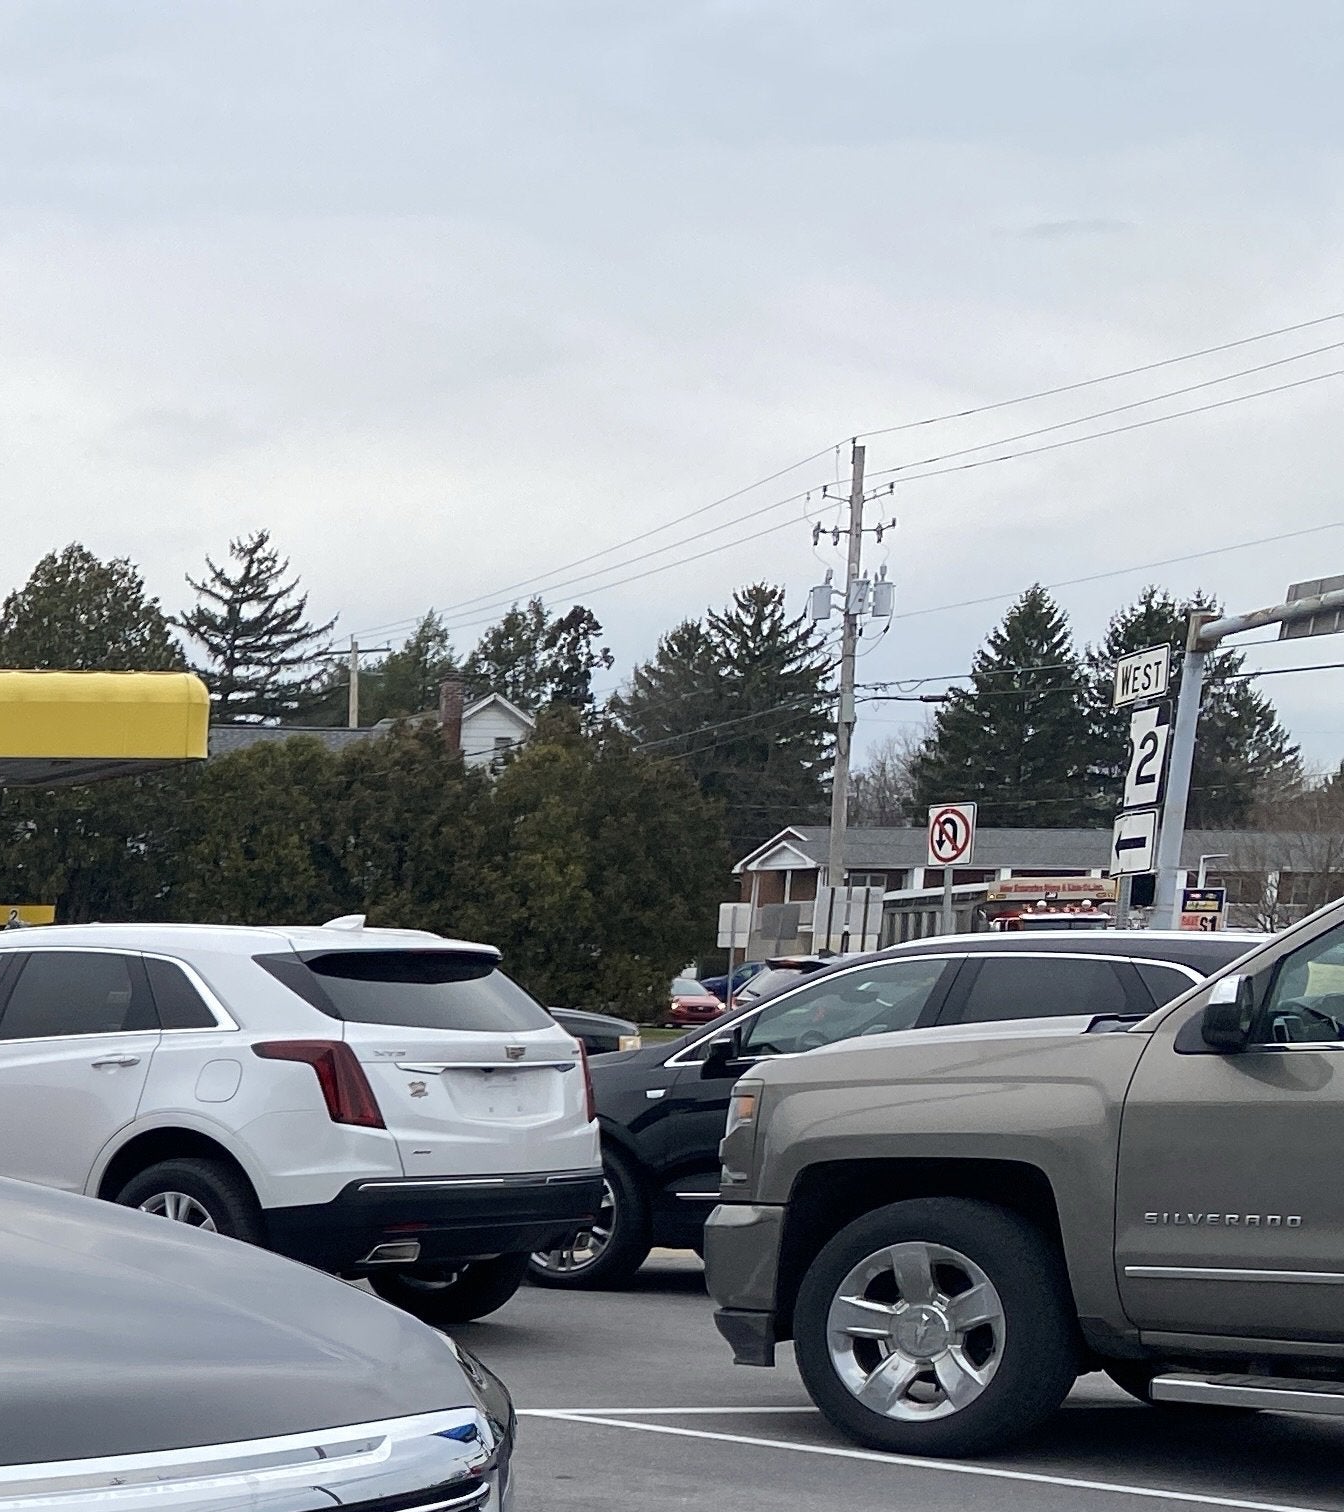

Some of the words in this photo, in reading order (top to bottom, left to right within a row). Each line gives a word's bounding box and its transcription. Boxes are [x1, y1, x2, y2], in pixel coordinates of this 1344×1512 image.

[1120, 660, 1163, 697] WEST
[1134, 730, 1159, 786] 2
[1144, 1212, 1303, 1229] SILVERADO
